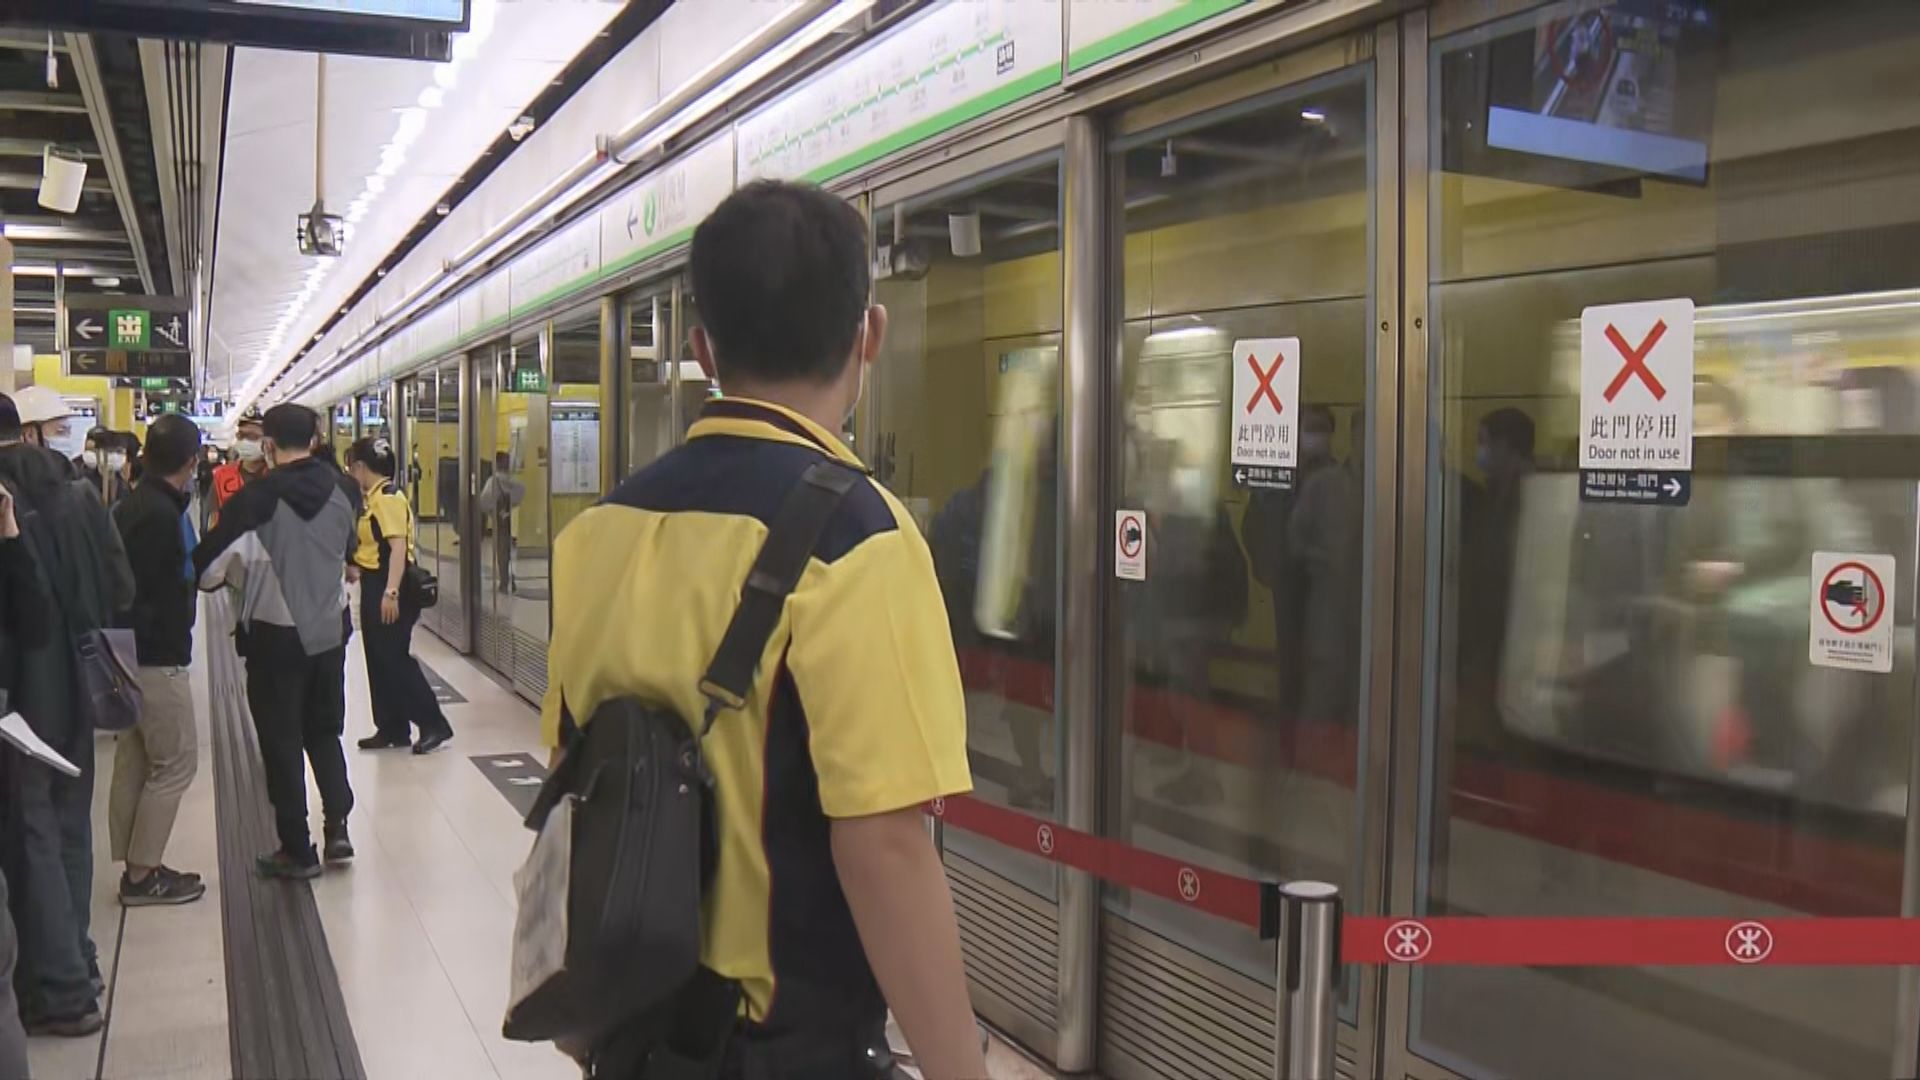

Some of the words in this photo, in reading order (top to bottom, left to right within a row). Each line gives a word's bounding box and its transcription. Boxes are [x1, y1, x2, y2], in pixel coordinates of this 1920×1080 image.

[117, 335, 142, 344] EXIT
[1238, 423, 1289, 444] 此門停用
[1590, 413, 1677, 439] 此門停用
[1236, 446, 1254, 457] Door
[1255, 448, 1268, 459] not
[1278, 450, 1290, 459] use
[1588, 444, 1617, 459] Door
[1620, 446, 1640, 459] not
[1643, 445, 1655, 459] in
[1659, 448, 1680, 459] use
